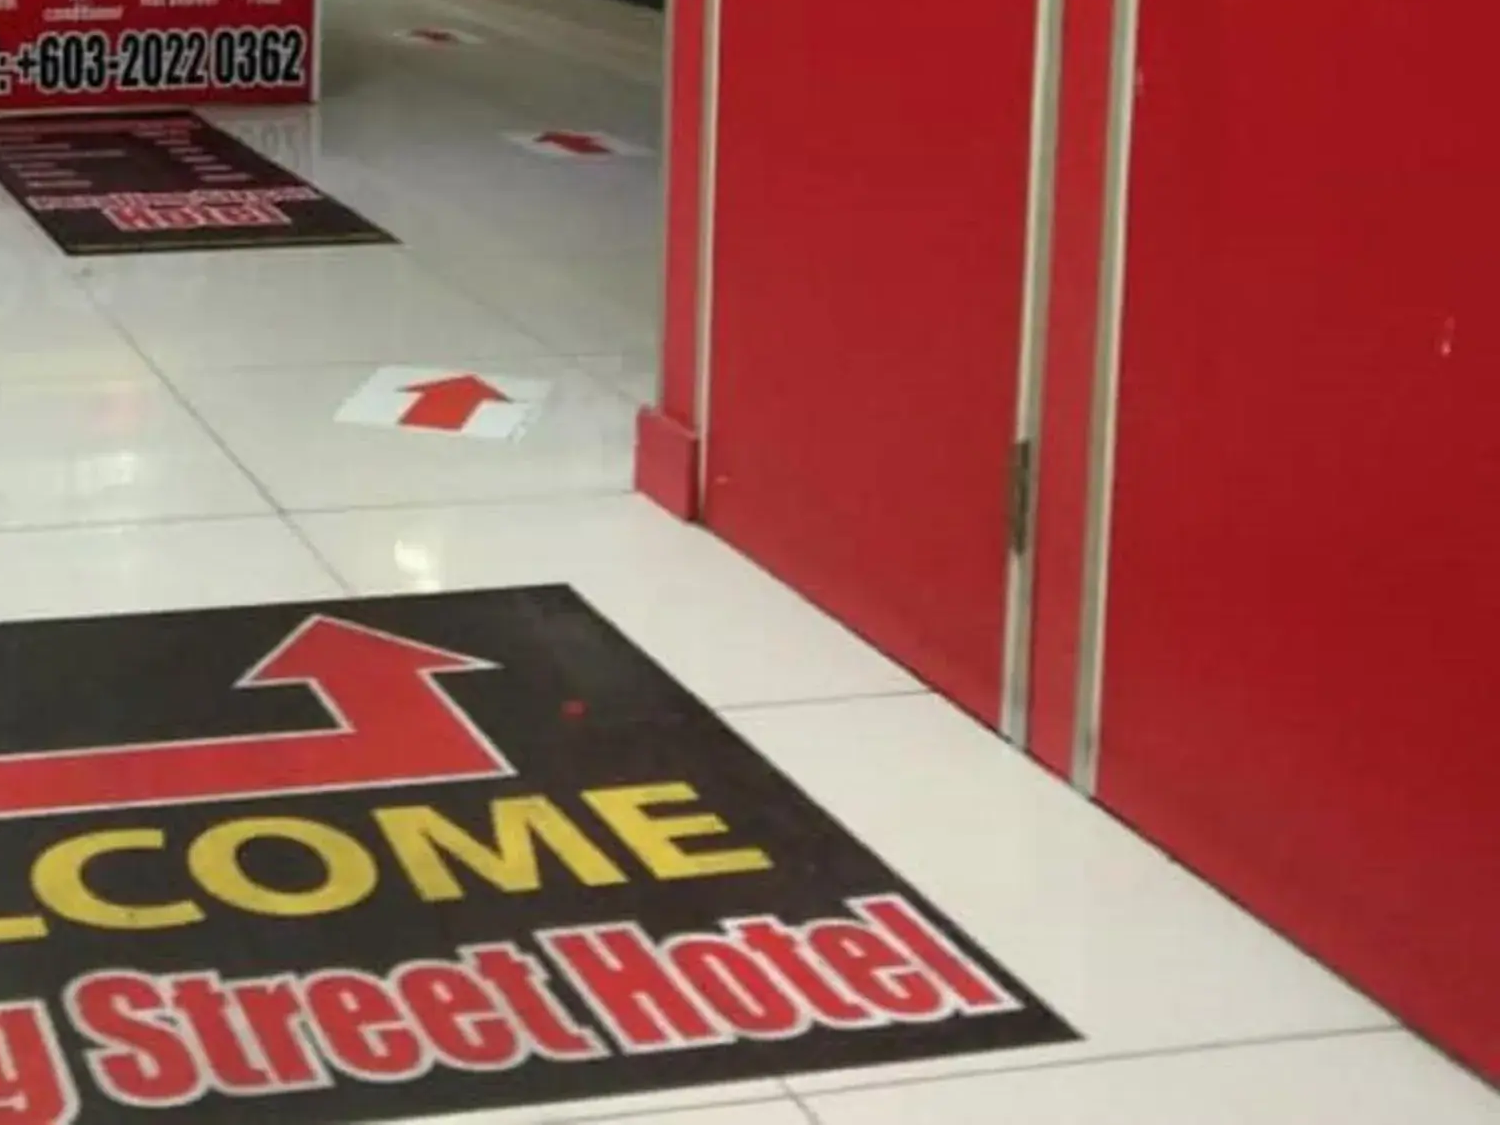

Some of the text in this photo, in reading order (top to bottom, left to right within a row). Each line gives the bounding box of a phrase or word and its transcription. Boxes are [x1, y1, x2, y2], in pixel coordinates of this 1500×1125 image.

[14, 28, 206, 92] +603-2022
[213, 28, 305, 88] 0362
[63, 967, 610, 1108] Street
[534, 890, 1024, 1055] Hotel
